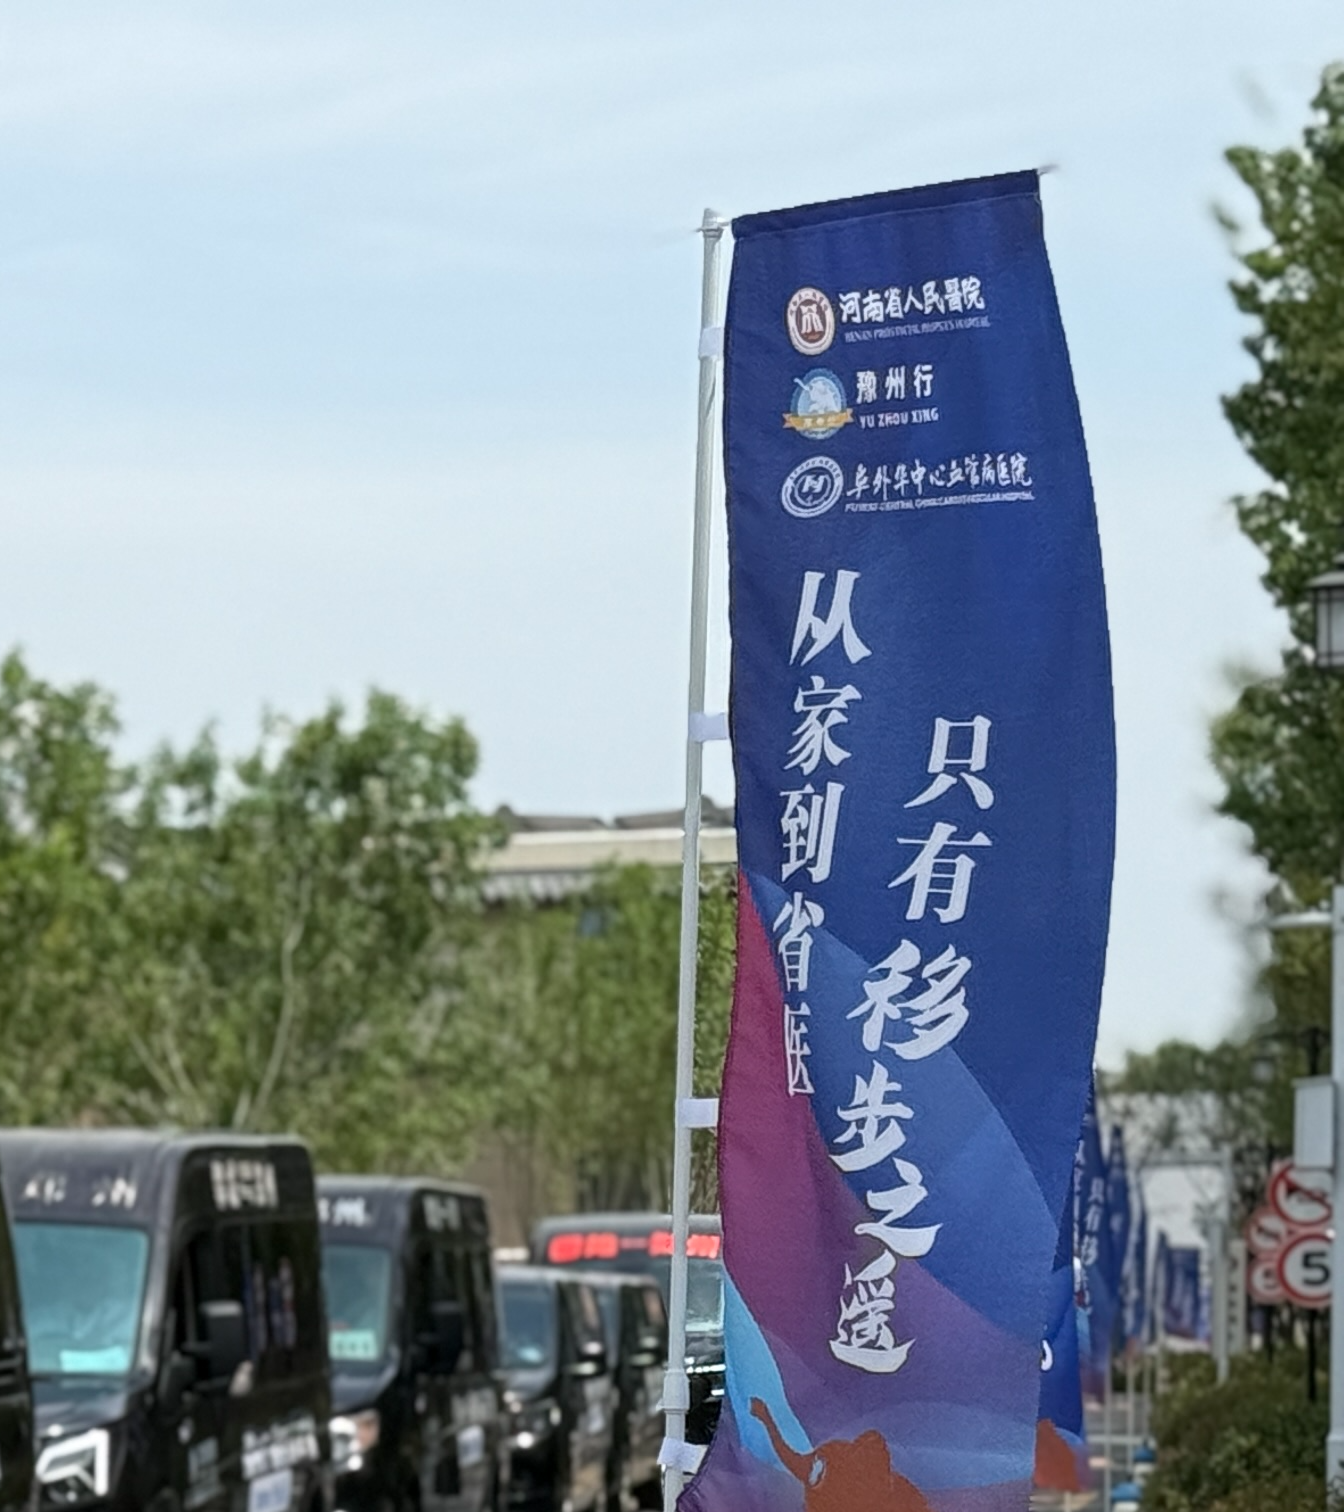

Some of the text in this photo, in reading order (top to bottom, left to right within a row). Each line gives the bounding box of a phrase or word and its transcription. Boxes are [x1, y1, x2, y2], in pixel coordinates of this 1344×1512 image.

[856, 364, 934, 404] 豫州行
[859, 414, 875, 429] YU
[877, 411, 909, 428] ZHOU
[911, 407, 939, 424] XING
[773, 570, 871, 1096] 从家到省医
[829, 715, 994, 1373] 只有移步之遥
[1302, 1252, 1330, 1286] 5
